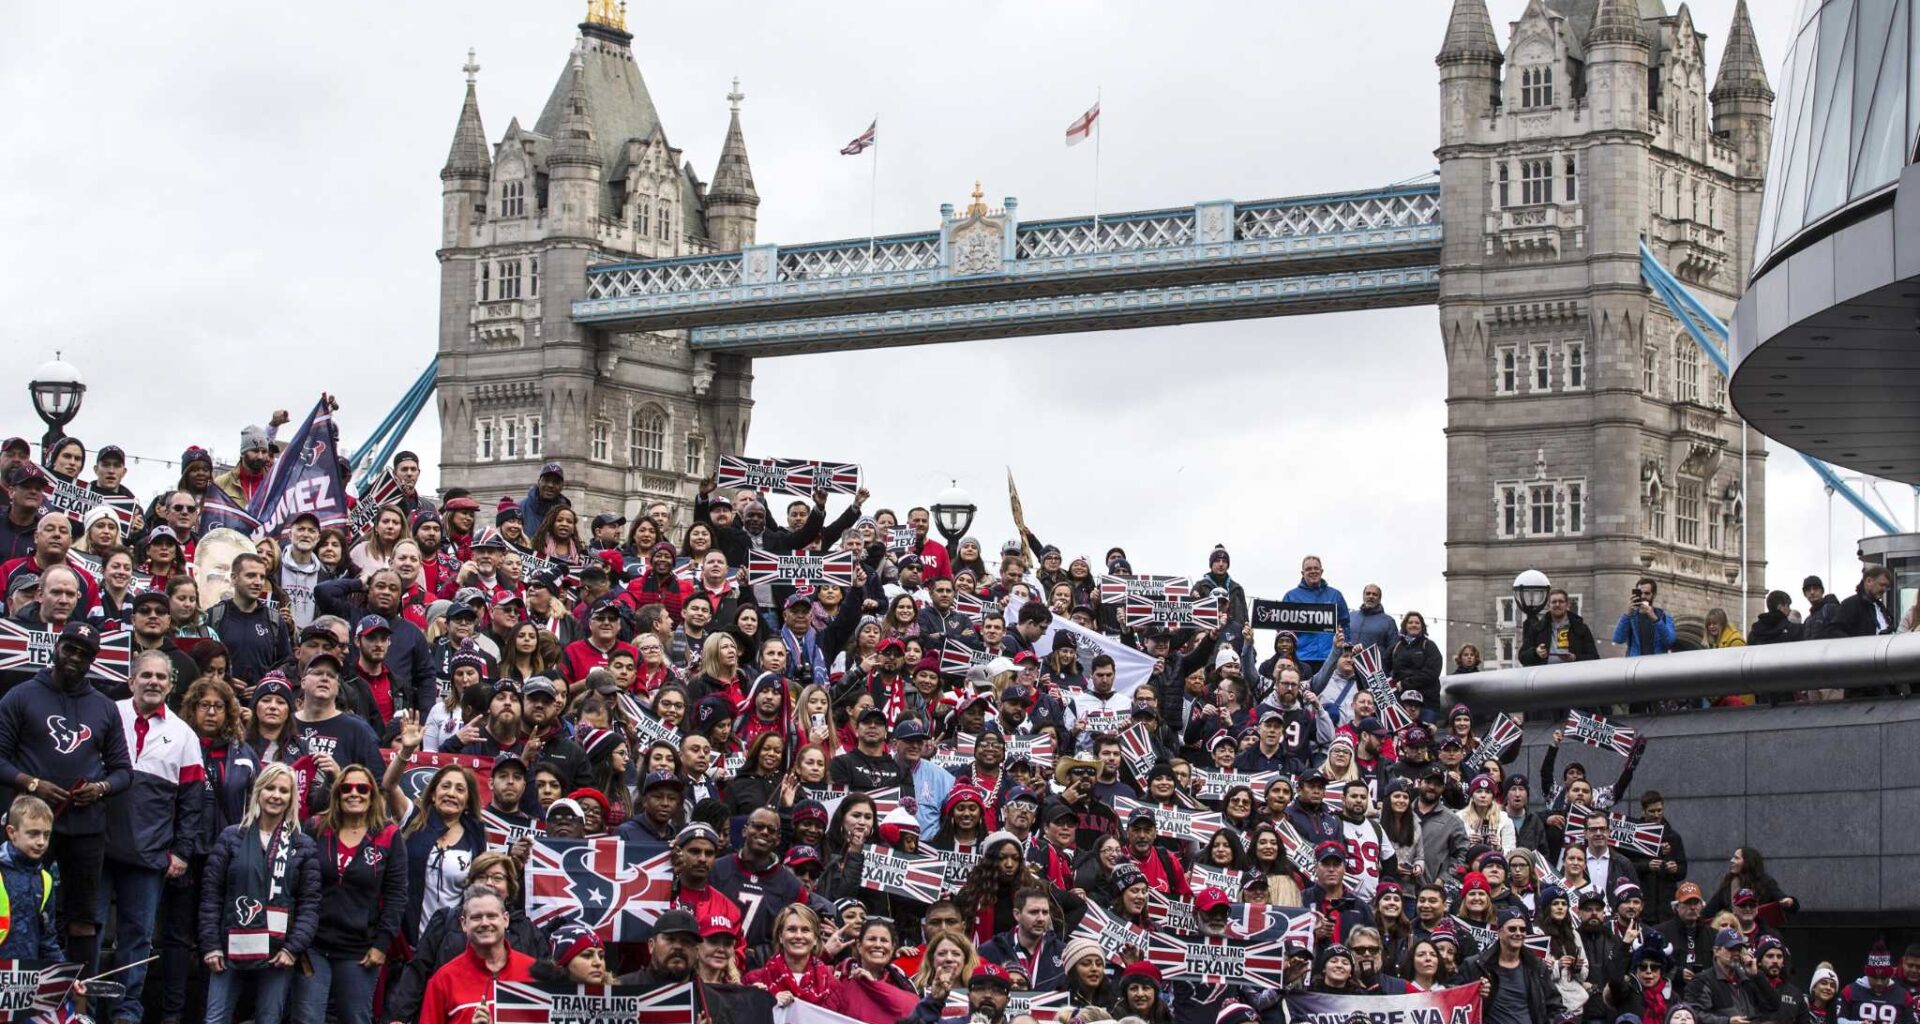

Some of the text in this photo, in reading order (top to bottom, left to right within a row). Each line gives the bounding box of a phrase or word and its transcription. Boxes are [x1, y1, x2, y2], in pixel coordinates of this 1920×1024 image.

[746, 464, 787, 477] TRAVELING
[745, 474, 786, 489] TEXANS
[56, 480, 104, 504] TRAVELING
[53, 493, 94, 516] TEXAN
[351, 503, 380, 534] EXANS
[779, 556, 823, 566] TRAVELING
[779, 567, 823, 580] TEXANS
[1127, 580, 1165, 588] TRAVELING
[1154, 601, 1193, 610] TRAVELING
[1153, 611, 1193, 622] TEXANS
[1271, 610, 1333, 625] HOUSTON
[29, 649, 55, 664] TEX
[1367, 674, 1388, 711] TEXANS
[641, 716, 682, 747] TRAVELIN
[1580, 716, 1615, 734] TRAVELING
[1577, 726, 1613, 744] TEXANS
[1005, 741, 1031, 749] ELING
[1207, 773, 1251, 783] TRAVELING
[863, 866, 905, 887] XANS
[1207, 872, 1240, 886] TRAVEL
[738, 891, 764, 938] 7
[1169, 900, 1193, 914] TRAVEL
[711, 915, 732, 929] HOU
[1100, 933, 1124, 950] TEX
[1107, 920, 1149, 951] TRAVELIN
[1186, 944, 1245, 959] TRAVELING
[1185, 958, 1245, 977] TEXANS
[0, 971, 39, 986] ELING
[0, 990, 35, 1009] ANS
[551, 995, 638, 1013] TRAVELING
[1859, 1003, 1897, 1024] 99
